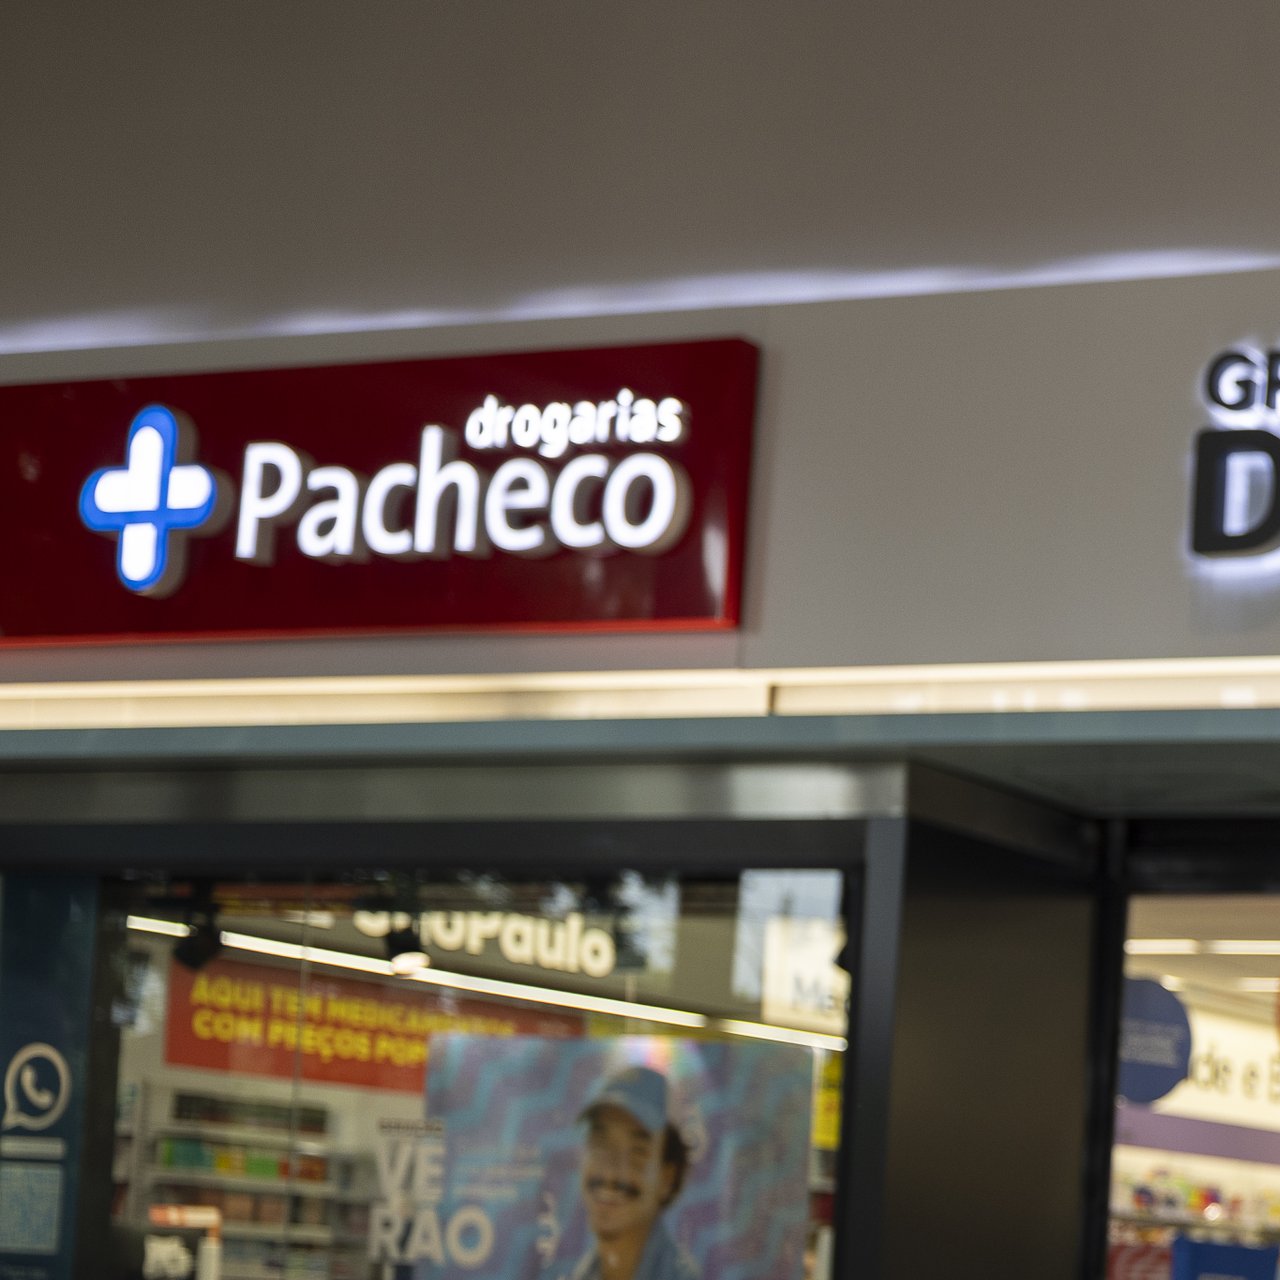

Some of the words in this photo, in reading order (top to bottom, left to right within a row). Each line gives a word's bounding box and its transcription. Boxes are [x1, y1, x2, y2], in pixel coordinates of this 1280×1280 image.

[465, 387, 685, 458] drogarias
[234, 424, 682, 561] Pacheco
[192, 1010, 261, 1047] COM
